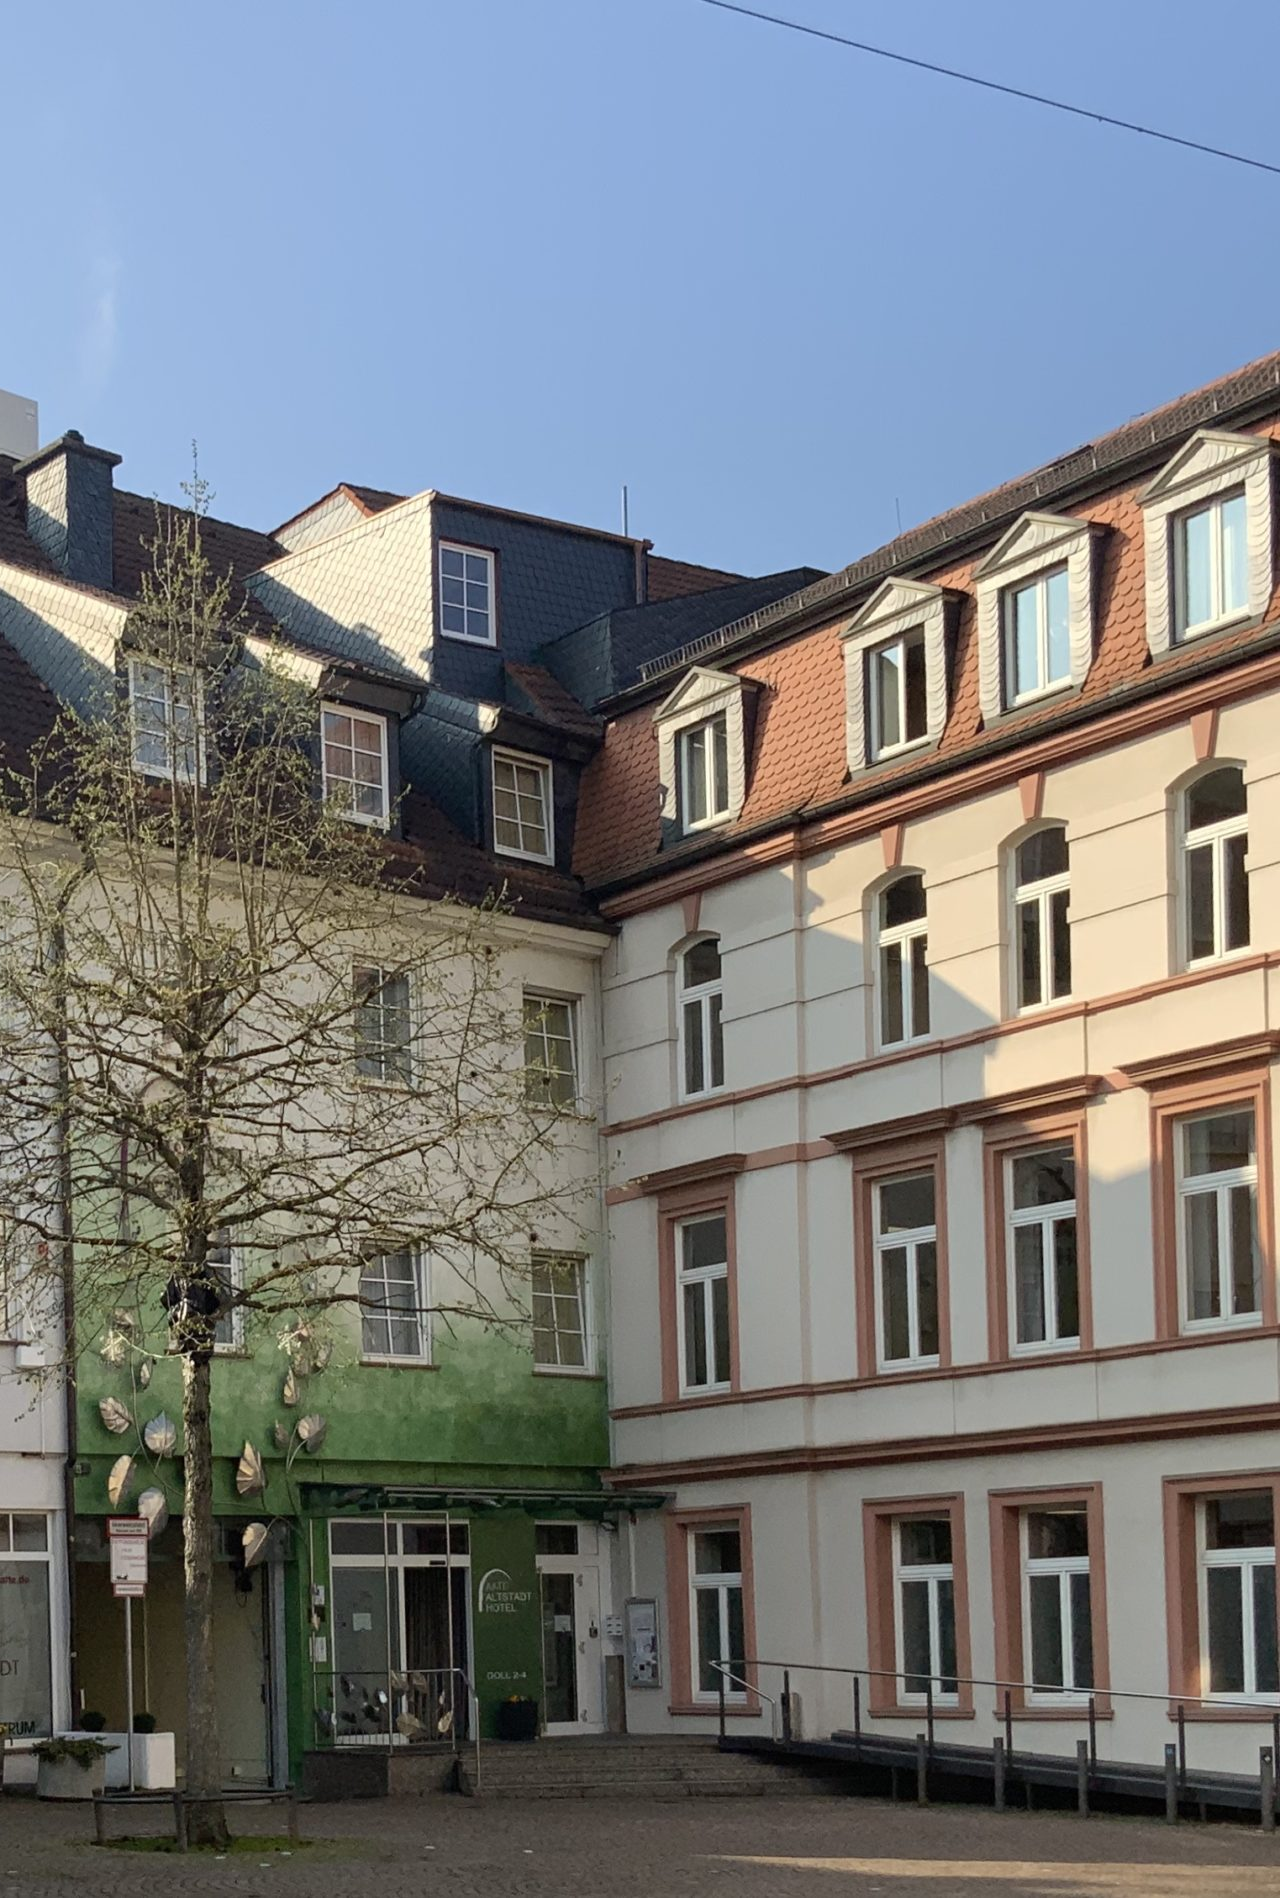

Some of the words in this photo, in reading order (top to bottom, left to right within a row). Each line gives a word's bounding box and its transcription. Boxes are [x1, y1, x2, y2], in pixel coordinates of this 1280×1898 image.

[485, 1592, 532, 1602] ALTSTADT
[485, 1603, 517, 1613] HOTEL
[486, 1671, 511, 1680] DOLL
